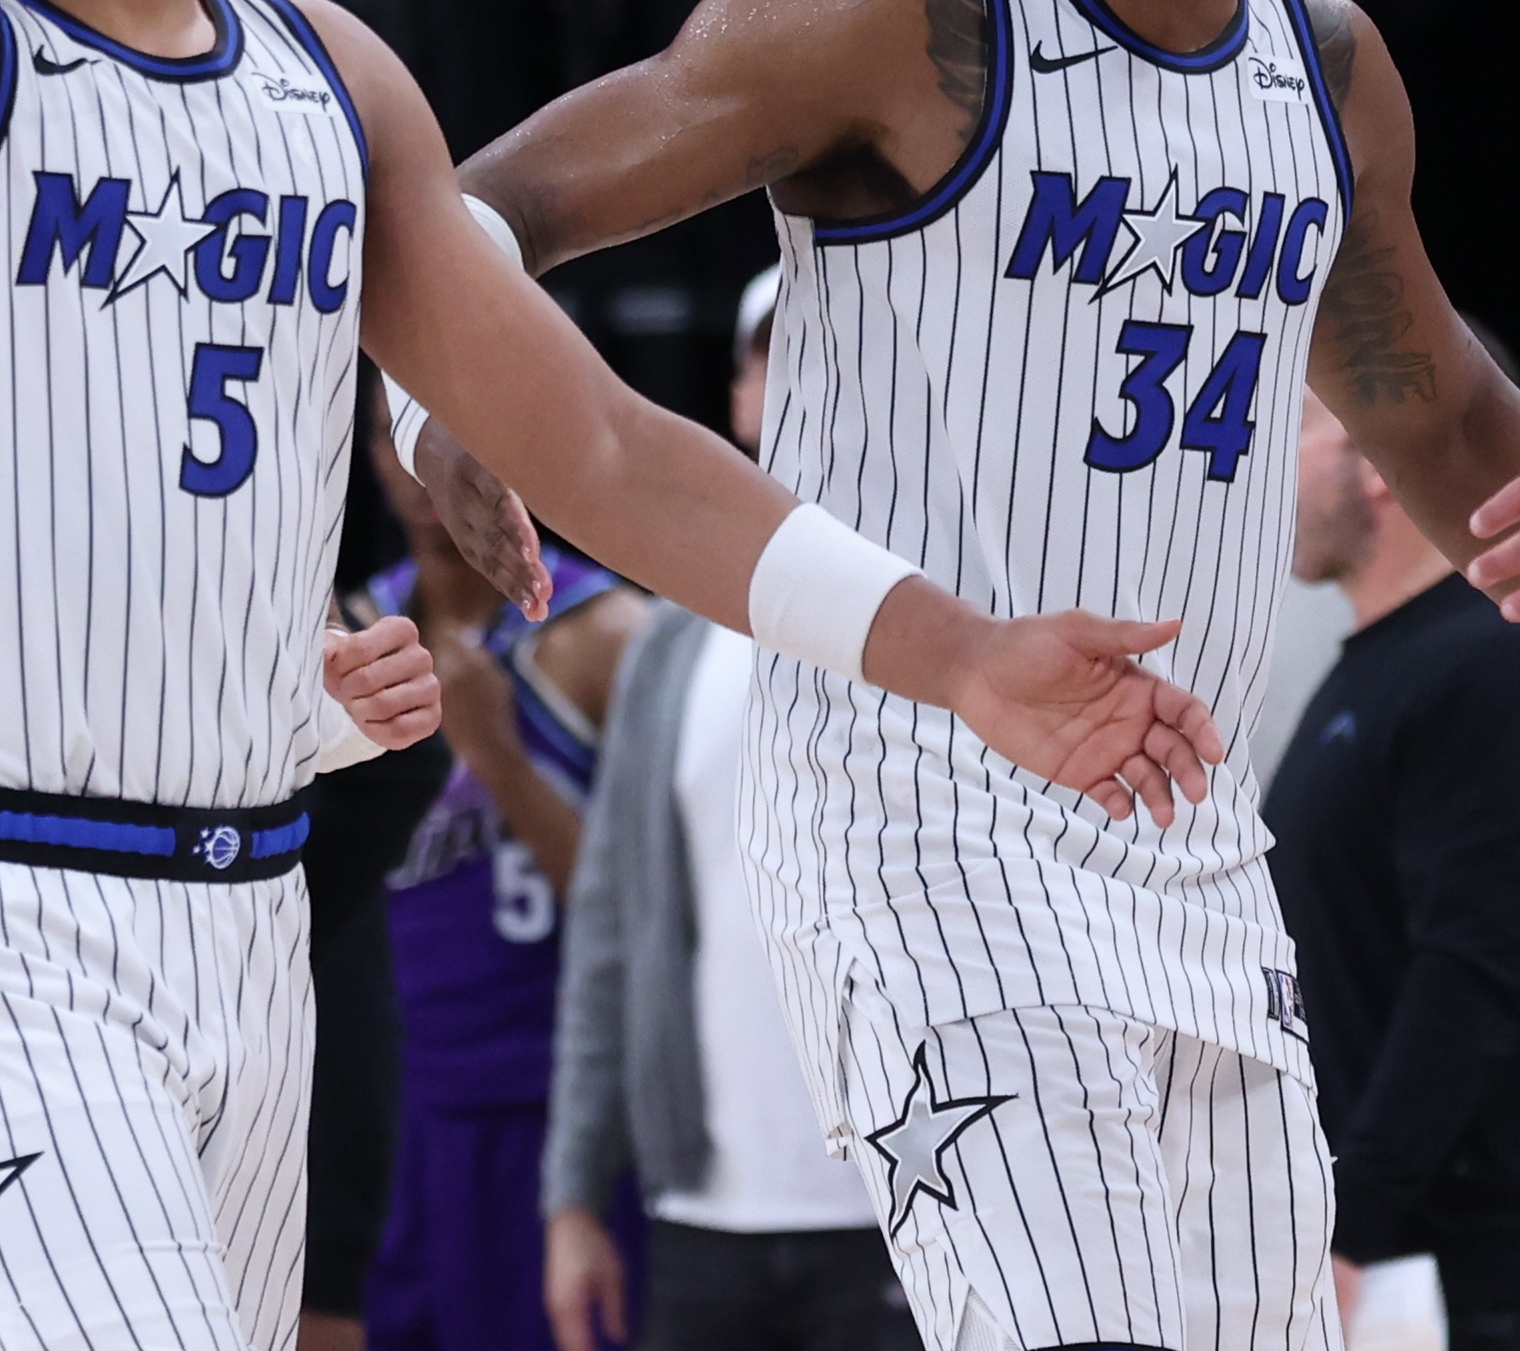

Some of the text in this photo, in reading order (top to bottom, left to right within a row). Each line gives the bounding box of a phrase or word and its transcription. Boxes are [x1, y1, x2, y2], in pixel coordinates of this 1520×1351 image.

[178, 342, 265, 498] 5
[1083, 319, 1268, 483] 34
[492, 840, 556, 943] 5
